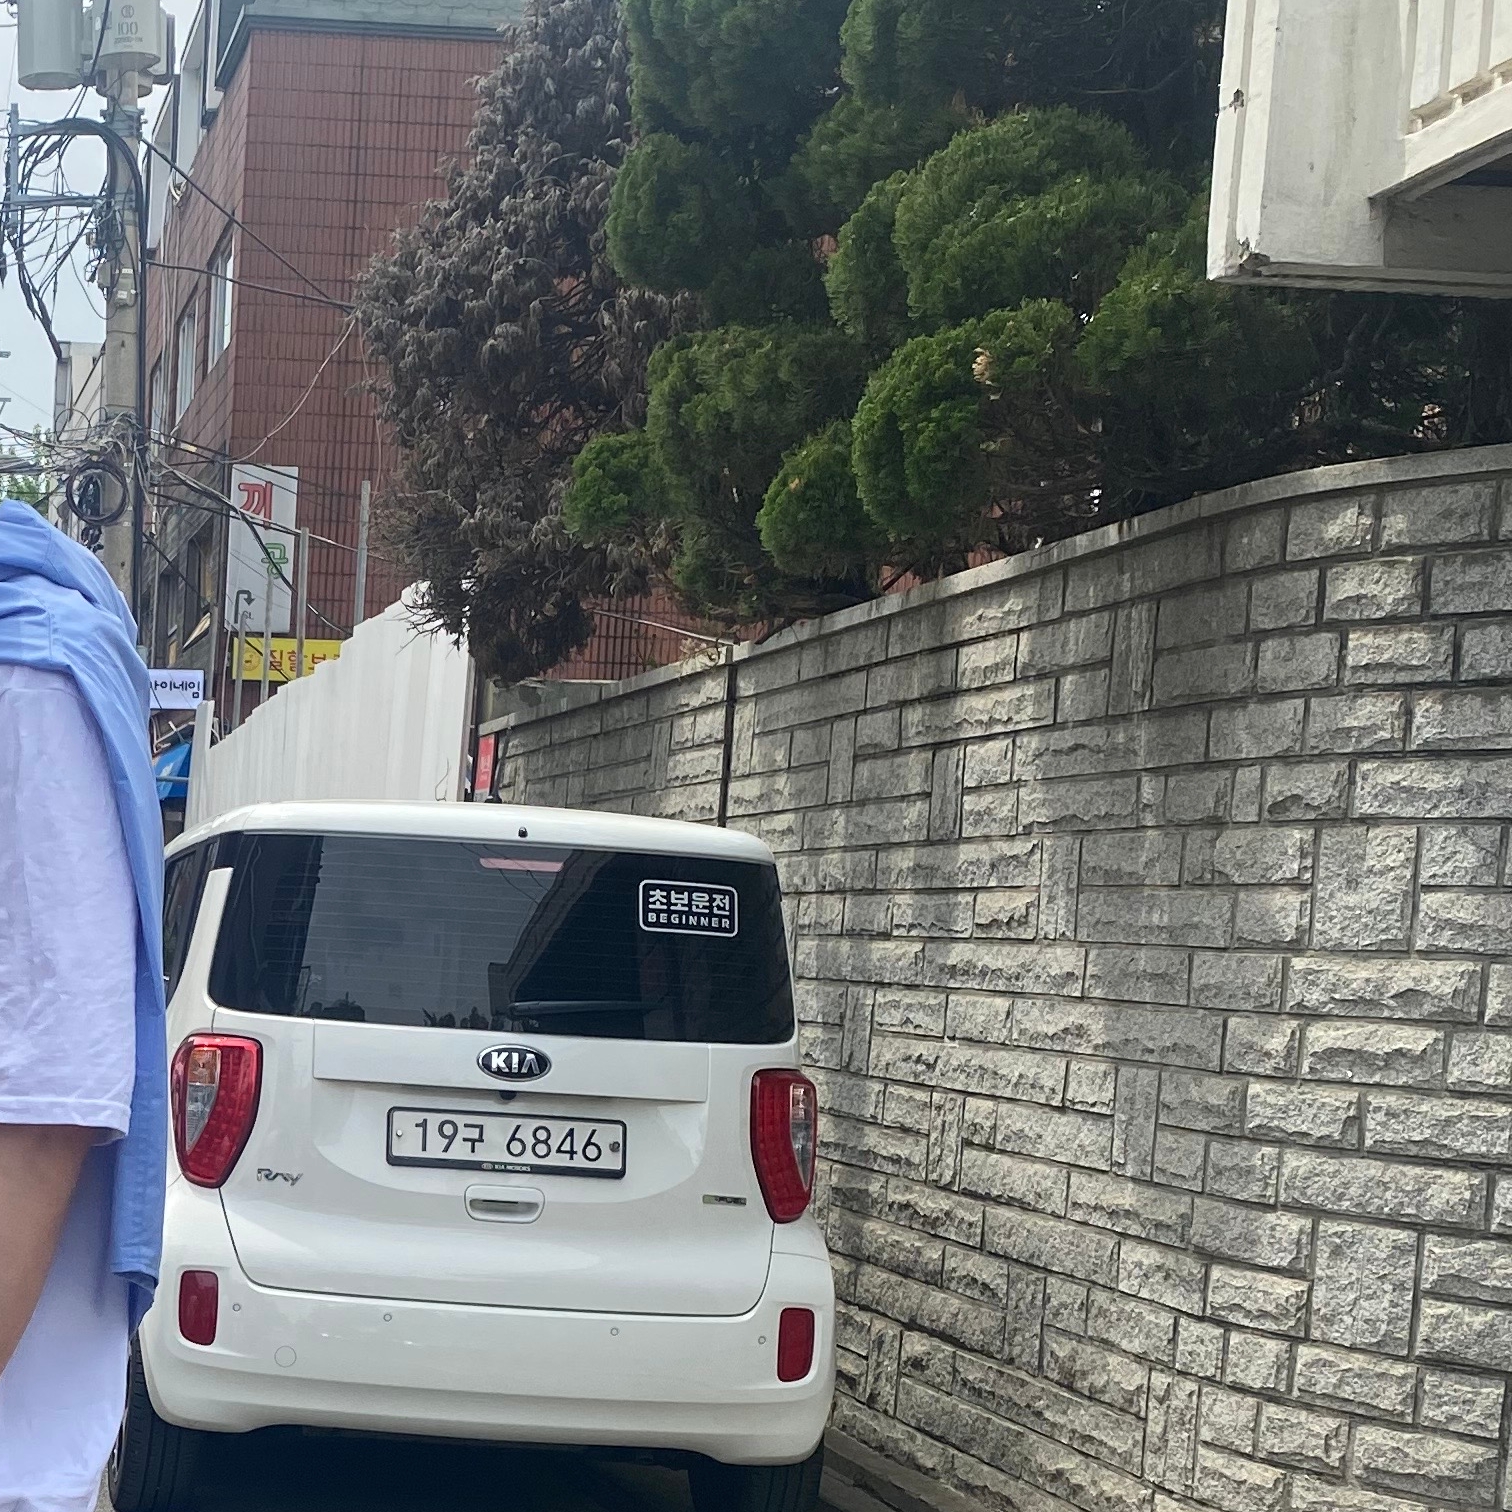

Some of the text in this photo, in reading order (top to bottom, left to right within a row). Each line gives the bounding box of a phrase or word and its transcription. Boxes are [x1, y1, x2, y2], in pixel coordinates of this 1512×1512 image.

[648, 889, 730, 916] 초보운전
[648, 912, 730, 929] BEGINNER
[491, 1051, 540, 1075] KIA
[415, 1118, 603, 1162] 19구 6846
